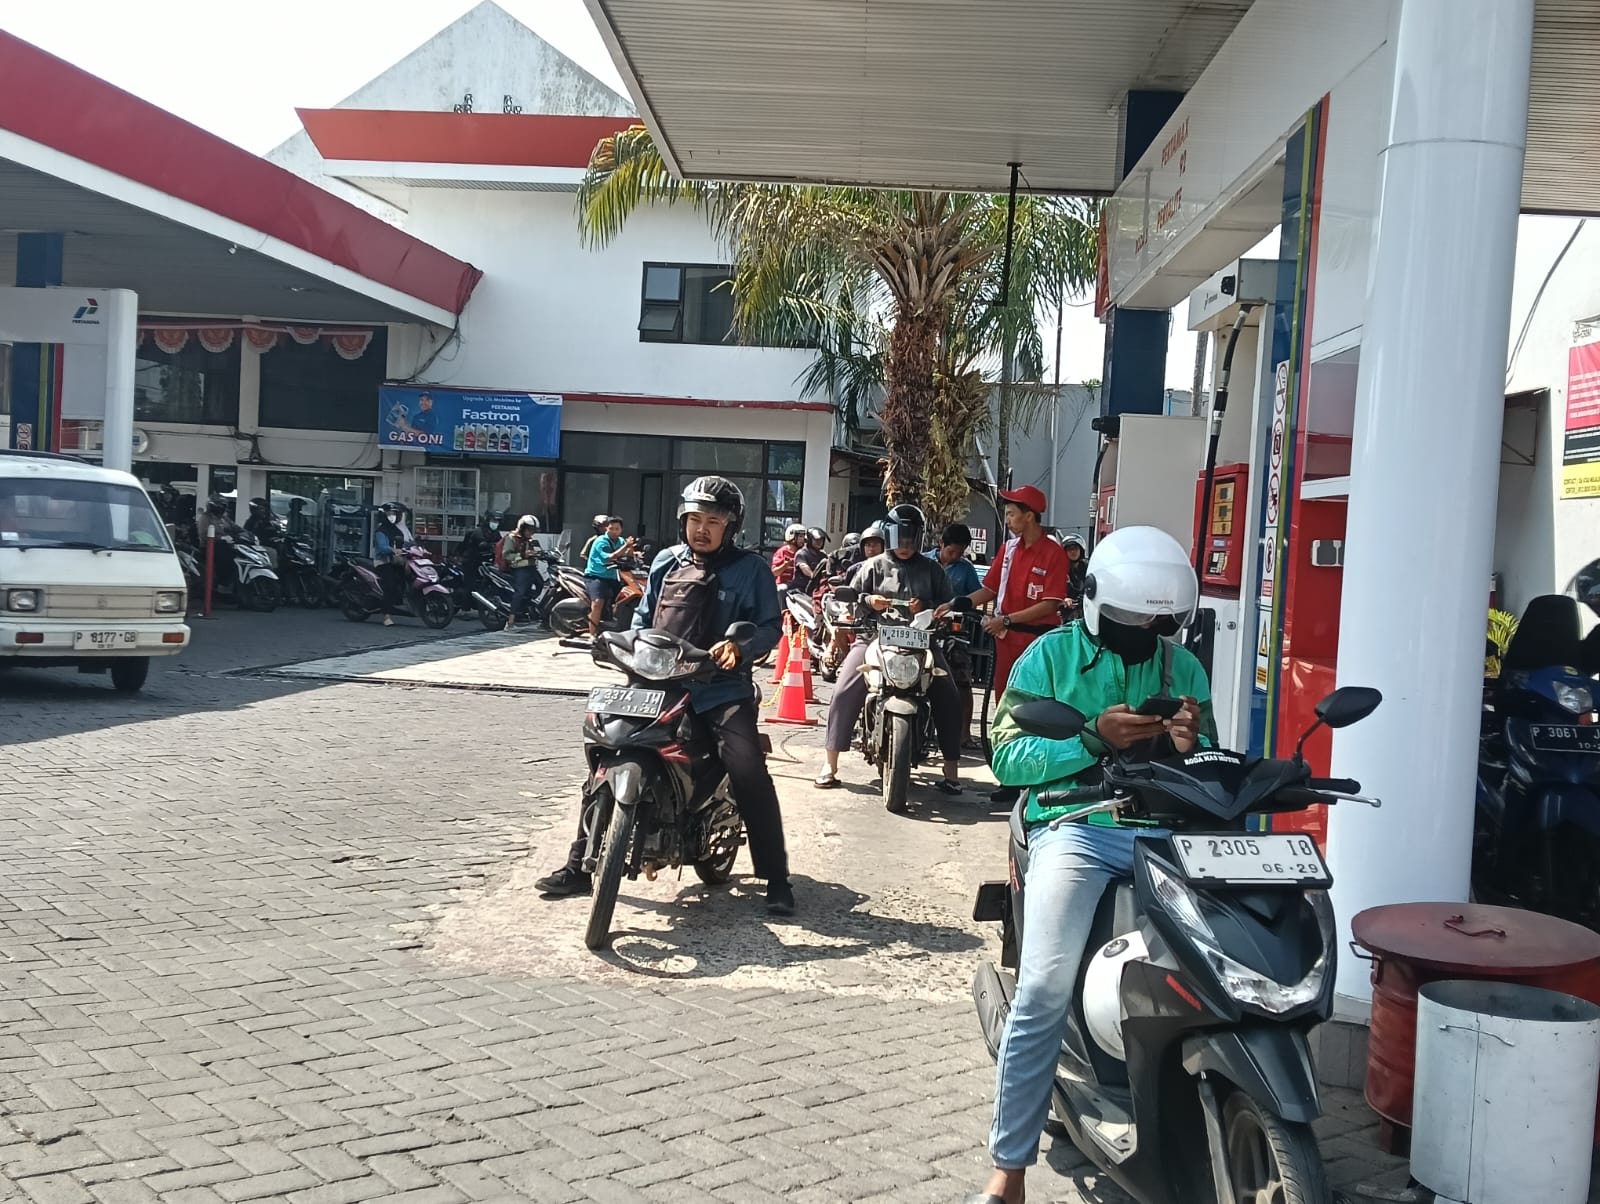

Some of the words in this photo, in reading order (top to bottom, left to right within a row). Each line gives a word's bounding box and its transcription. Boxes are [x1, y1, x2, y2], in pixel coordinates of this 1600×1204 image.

[462, 408, 520, 422] Fastron
[388, 431, 414, 442] GAS
[418, 432, 443, 445] ON!
[76, 632, 82, 642] P
[91, 632, 116, 643] 8177
[882, 629, 887, 637] N
[891, 629, 910, 639] 2199
[592, 688, 600, 698] P
[1532, 727, 1540, 737] P
[1548, 727, 1578, 739] 3061
[1181, 839, 1192, 857] P
[1207, 840, 1261, 857] 2305
